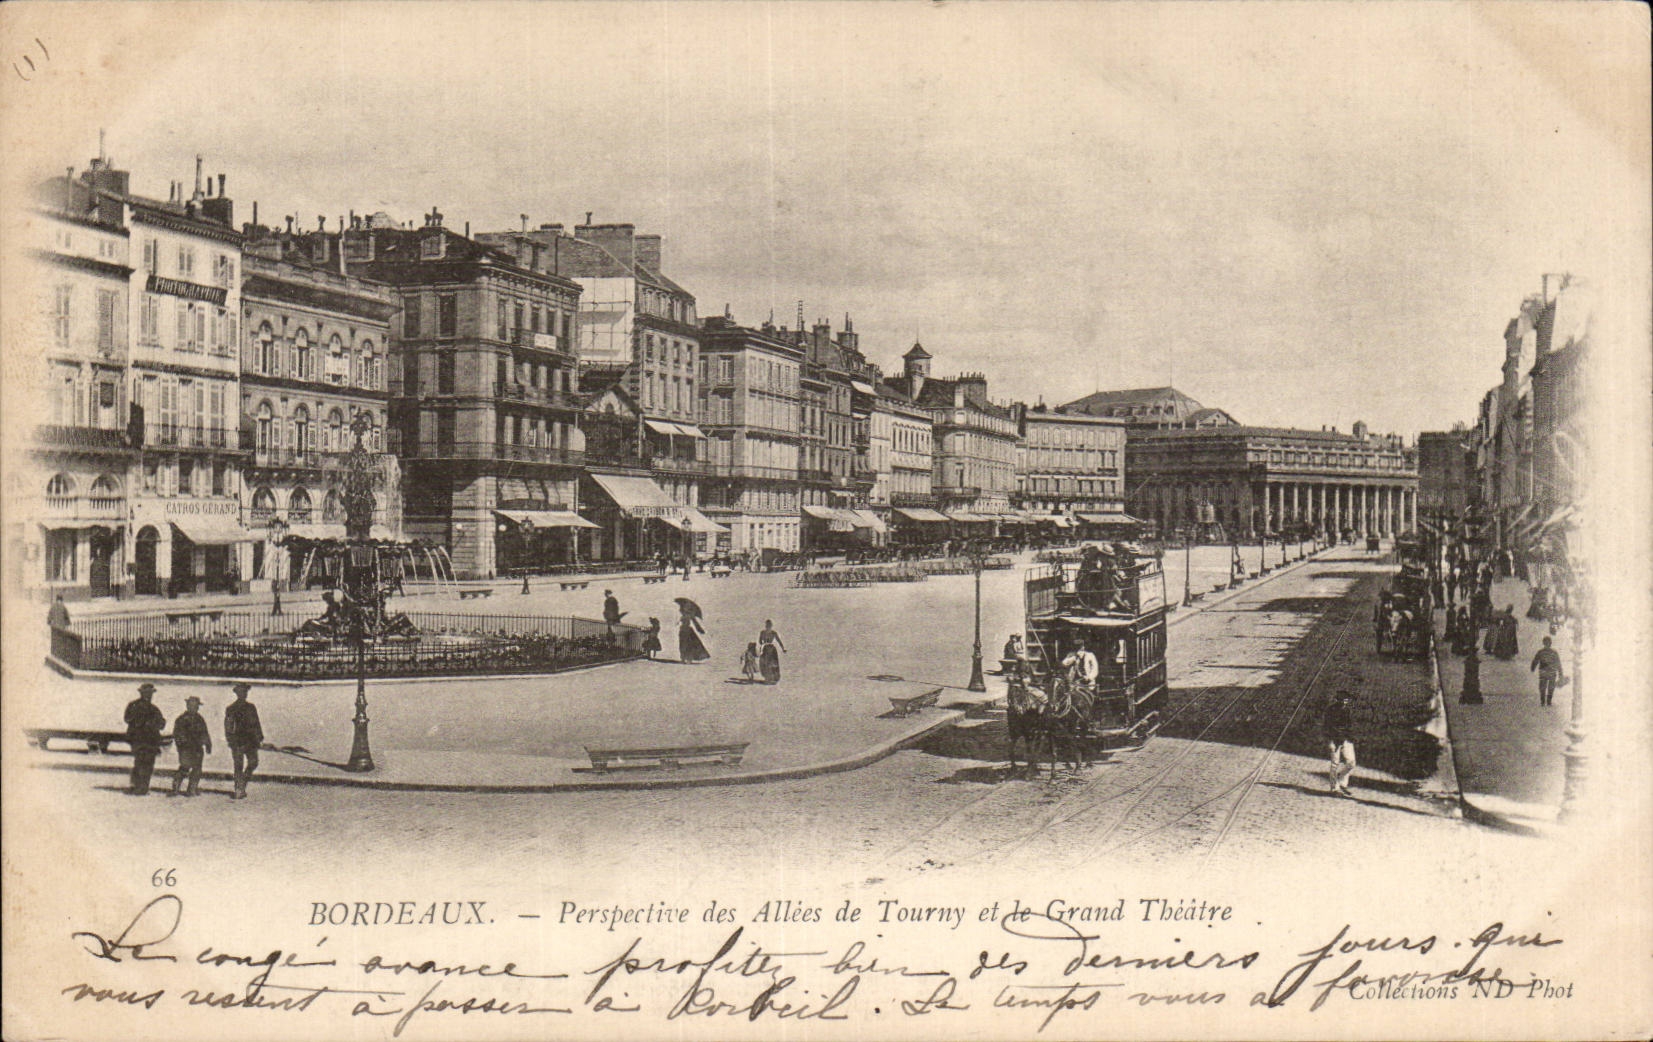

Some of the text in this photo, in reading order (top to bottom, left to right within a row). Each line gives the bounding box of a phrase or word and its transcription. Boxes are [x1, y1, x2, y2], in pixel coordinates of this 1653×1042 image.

[166, 502, 200, 515] CATROS
[72, 894, 183, 963] Le
[196, 936, 336, 1003] congé
[360, 955, 568, 978] avance
[584, 926, 800, 1012] profitez
[822, 934, 950, 976] bien
[969, 950, 1028, 979] des
[1018, 912, 1260, 976] derniers
[61, 983, 165, 1010] vous
[351, 994, 403, 1017] à
[393, 980, 573, 1038] passer
[901, 977, 970, 1016] Le
[992, 982, 1112, 1033] temps
[1127, 991, 1227, 1008] vous
